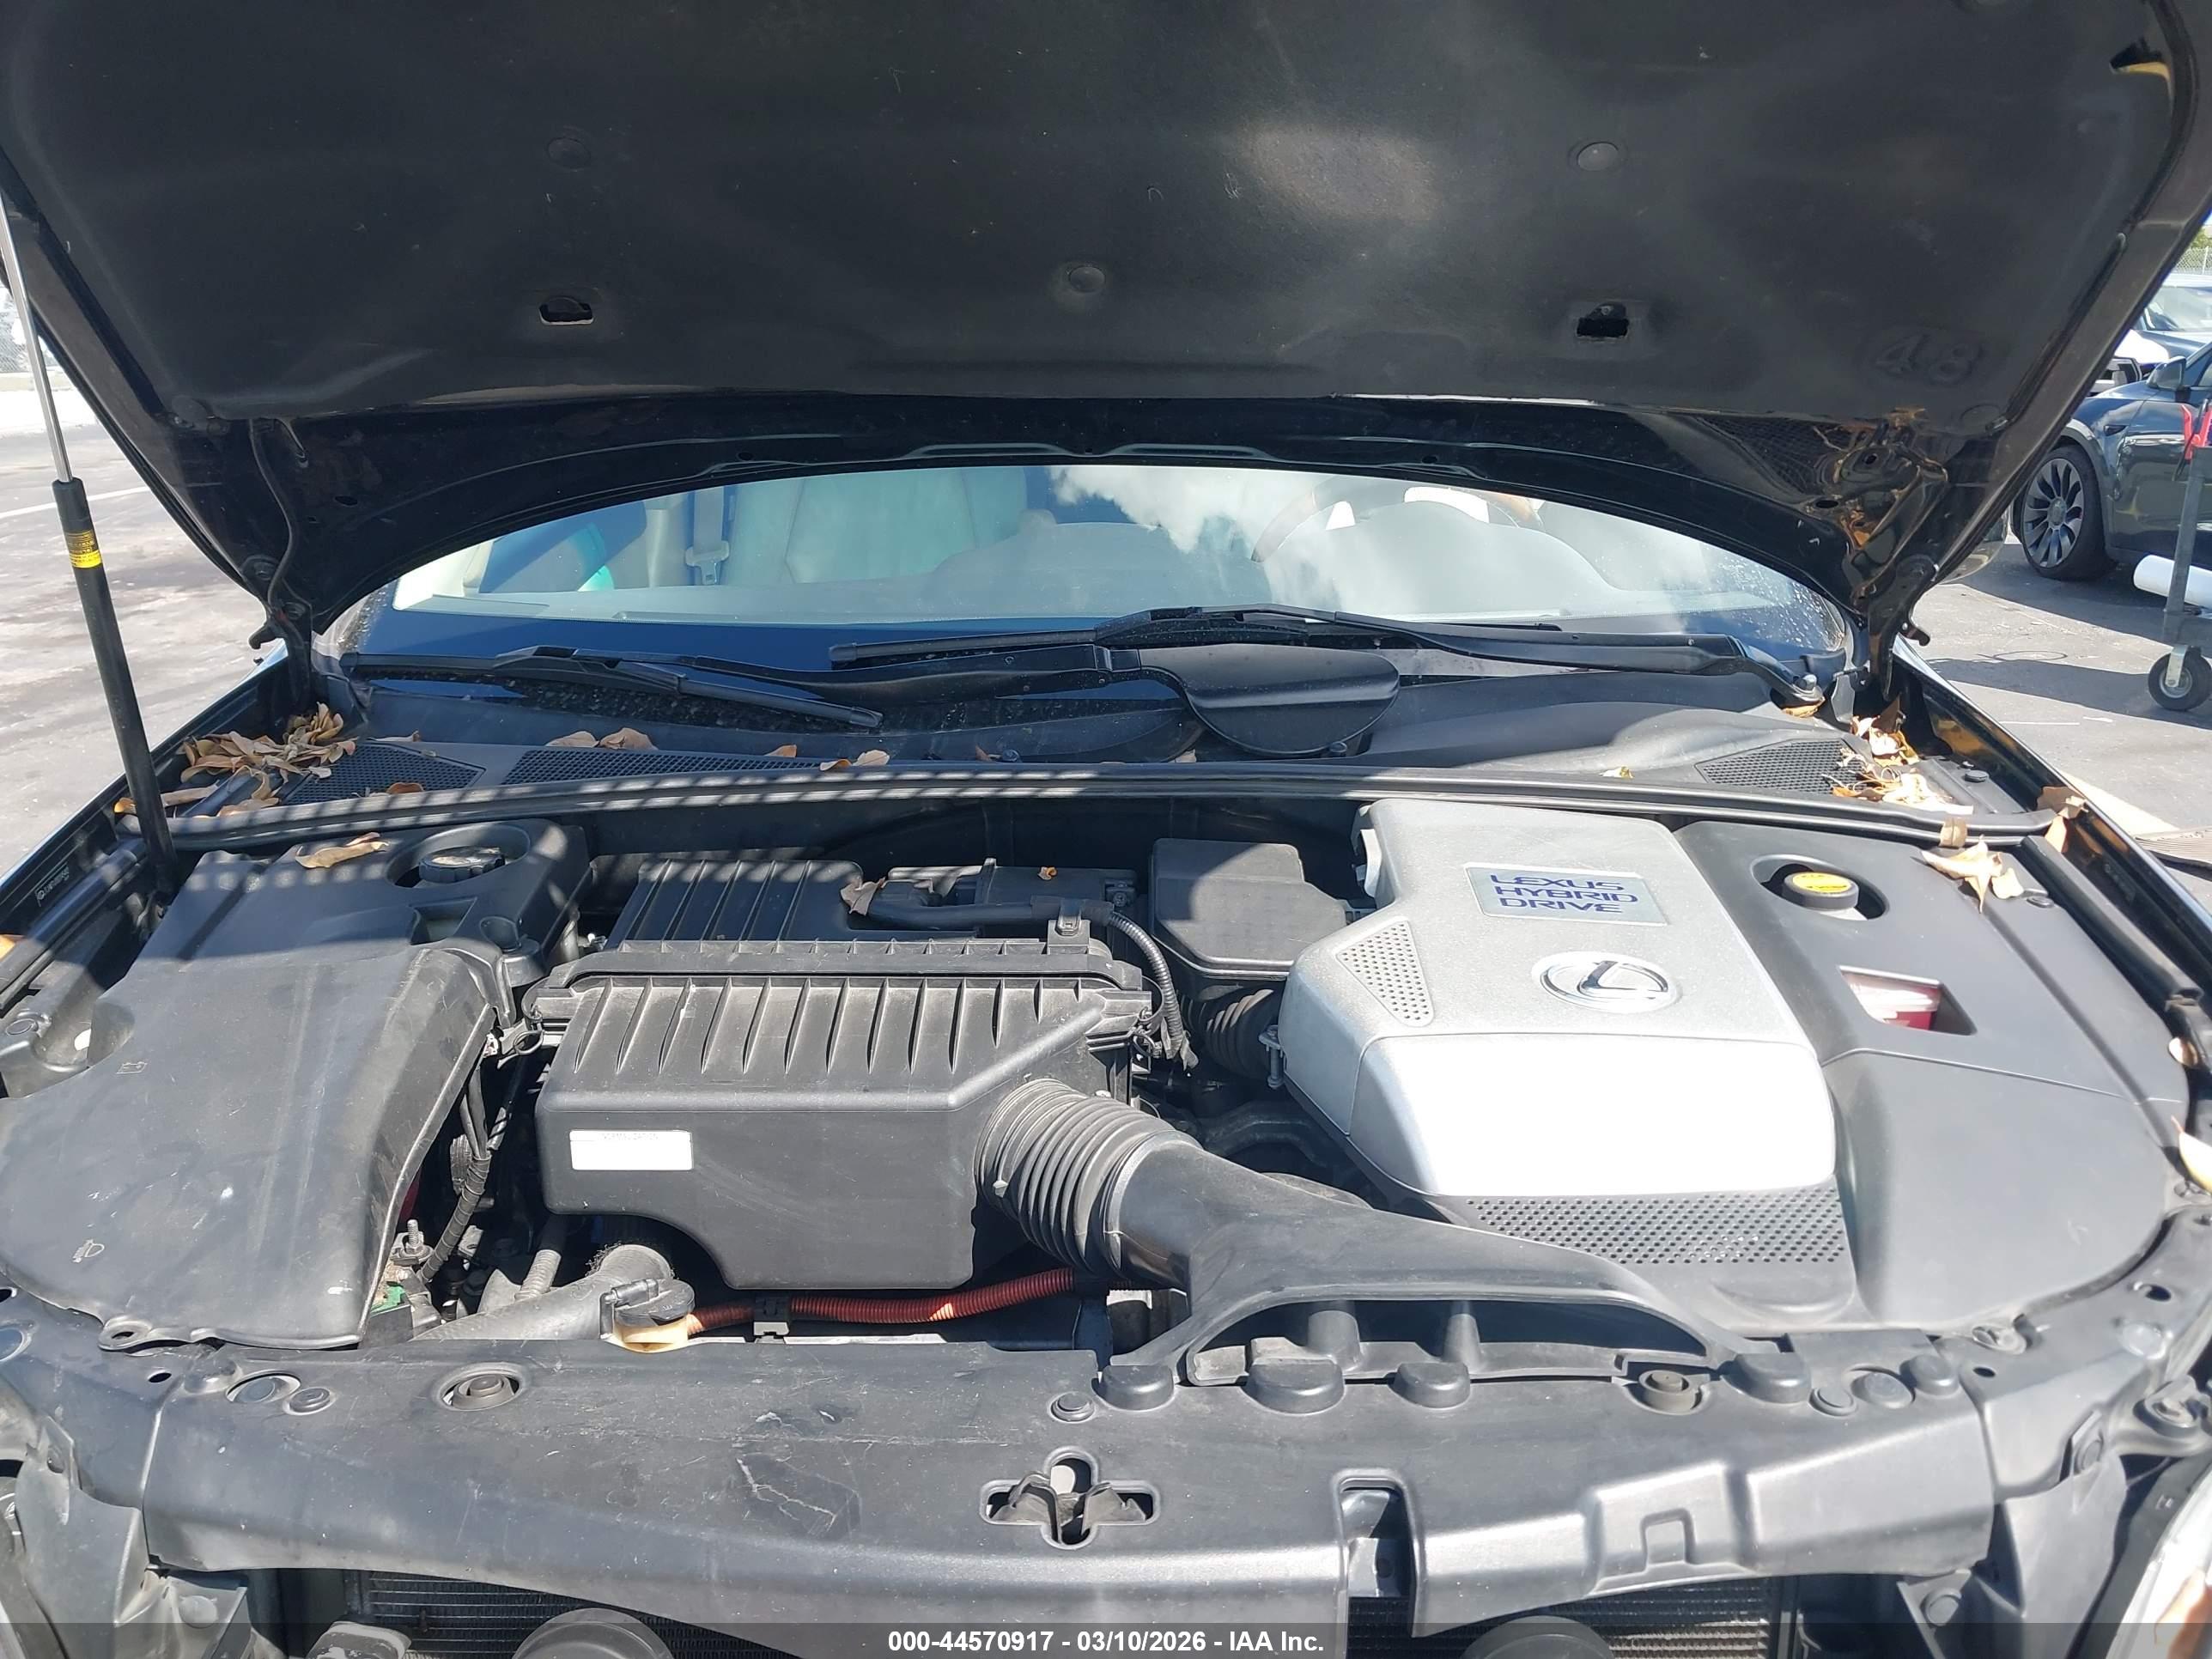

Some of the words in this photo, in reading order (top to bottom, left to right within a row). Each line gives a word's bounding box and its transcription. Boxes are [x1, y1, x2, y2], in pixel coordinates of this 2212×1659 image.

[1490, 874, 1625, 891] LEXUS
[1494, 885, 1638, 902] HYBRID
[1499, 897, 1623, 914] DRIVE
